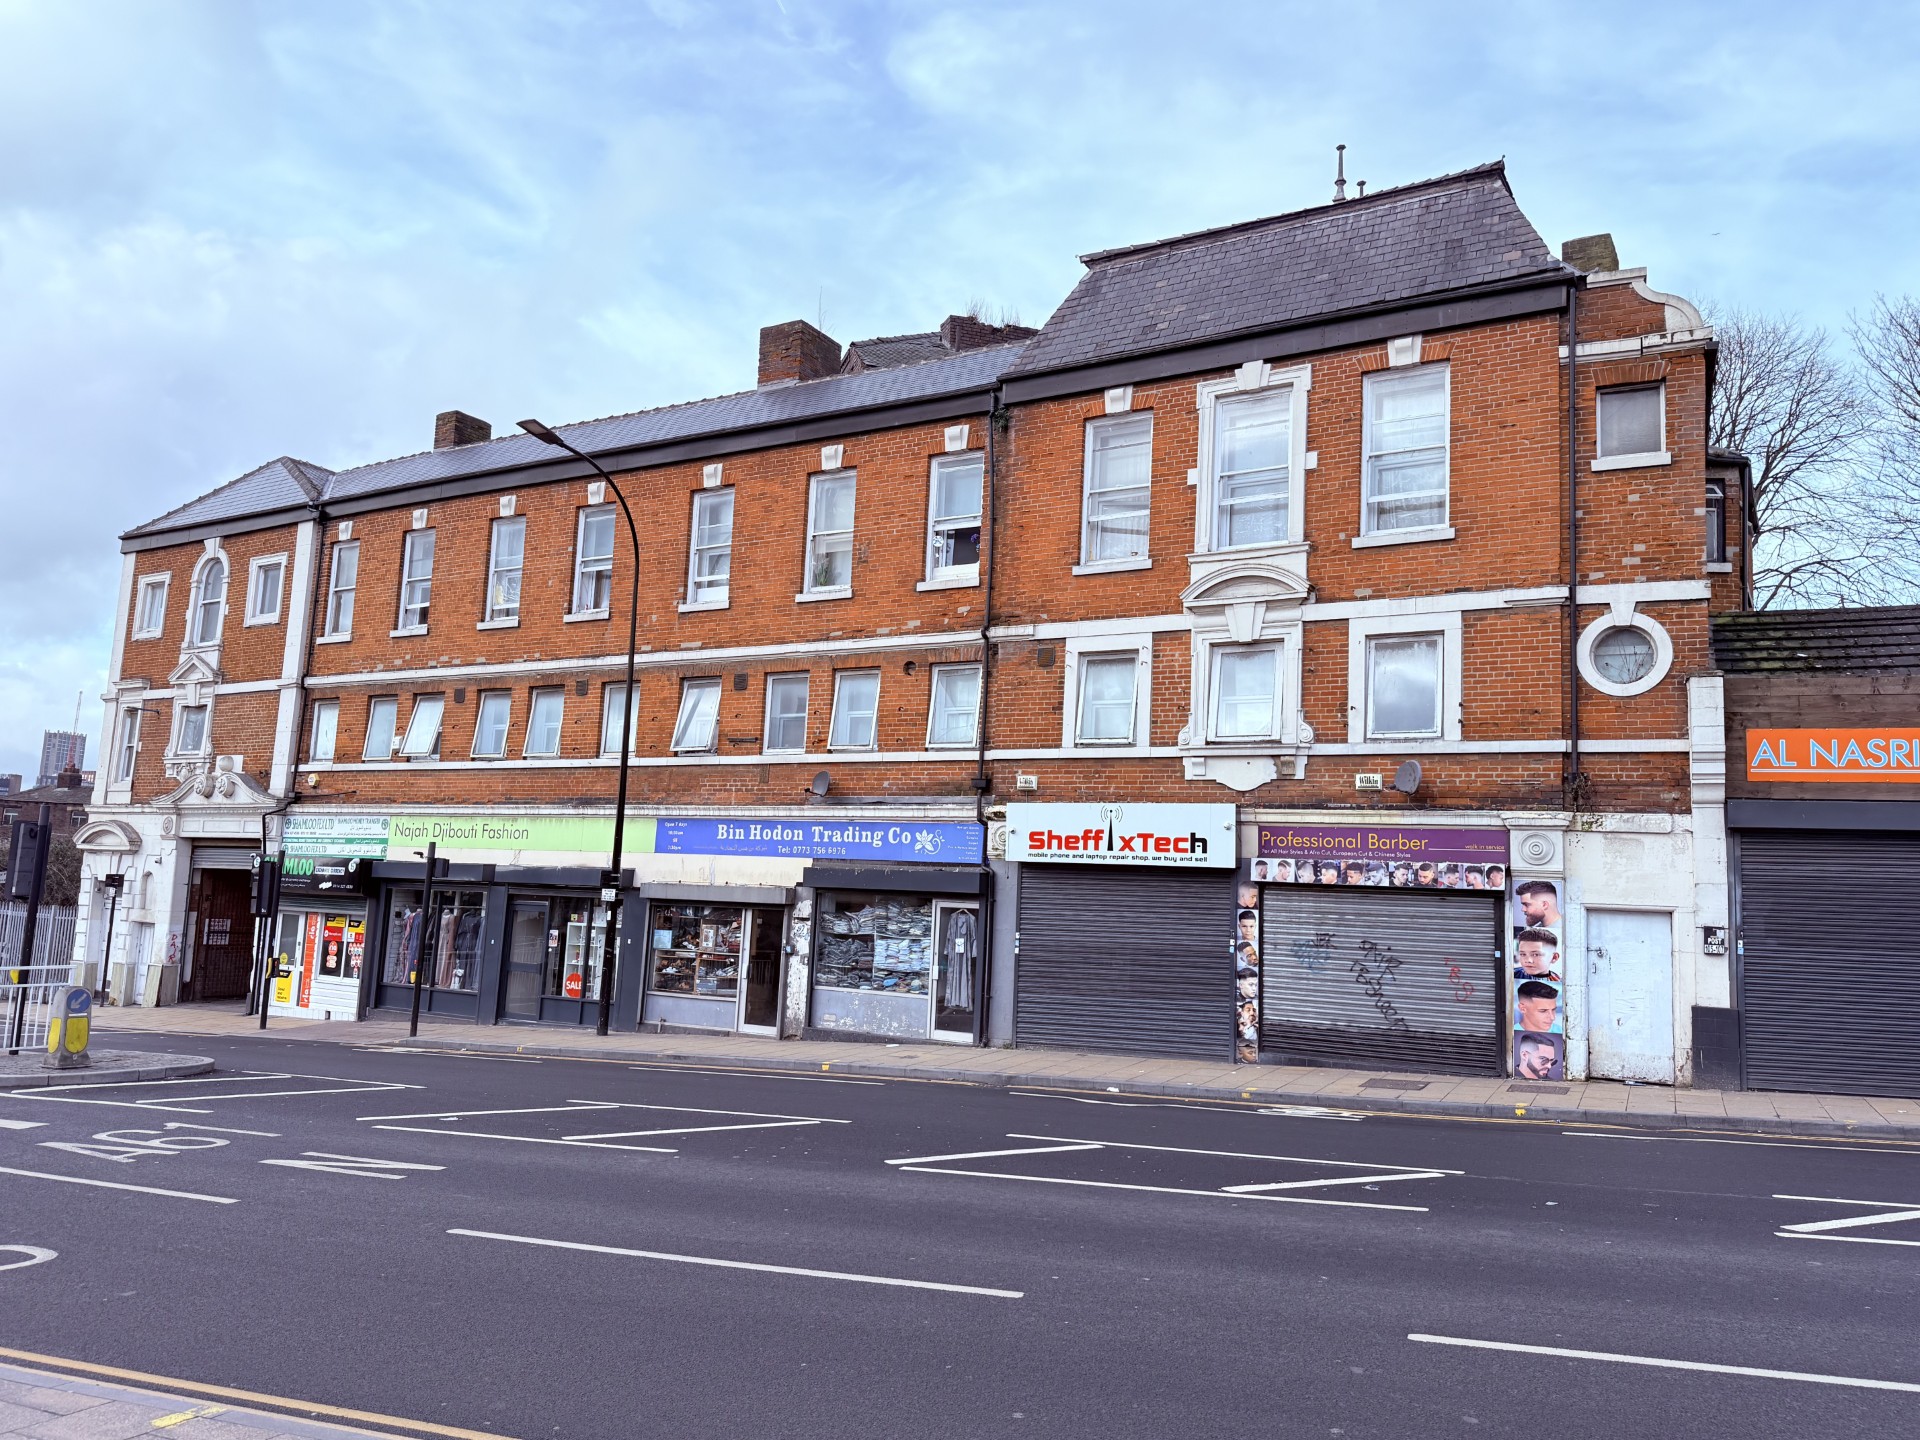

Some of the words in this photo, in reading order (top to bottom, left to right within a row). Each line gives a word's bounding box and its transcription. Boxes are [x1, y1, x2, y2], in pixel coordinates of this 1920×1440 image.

[1752, 739, 1797, 767] AL
[1810, 739, 1919, 768] NASRI
[394, 822, 428, 841] Najah
[432, 822, 478, 842] Djibouti
[481, 823, 529, 840] Fashion
[717, 824, 745, 840] Bin
[749, 824, 803, 841] Hodon
[811, 826, 884, 848] Trading
[888, 827, 912, 844] Co
[1261, 831, 1362, 850] Professional
[1368, 833, 1429, 851] Barber
[778, 845, 791, 854] Tel:
[792, 846, 811, 854] 0773
[812, 846, 826, 854] 756
[827, 847, 846, 855] 6976
[1085, 853, 1107, 861] laptop
